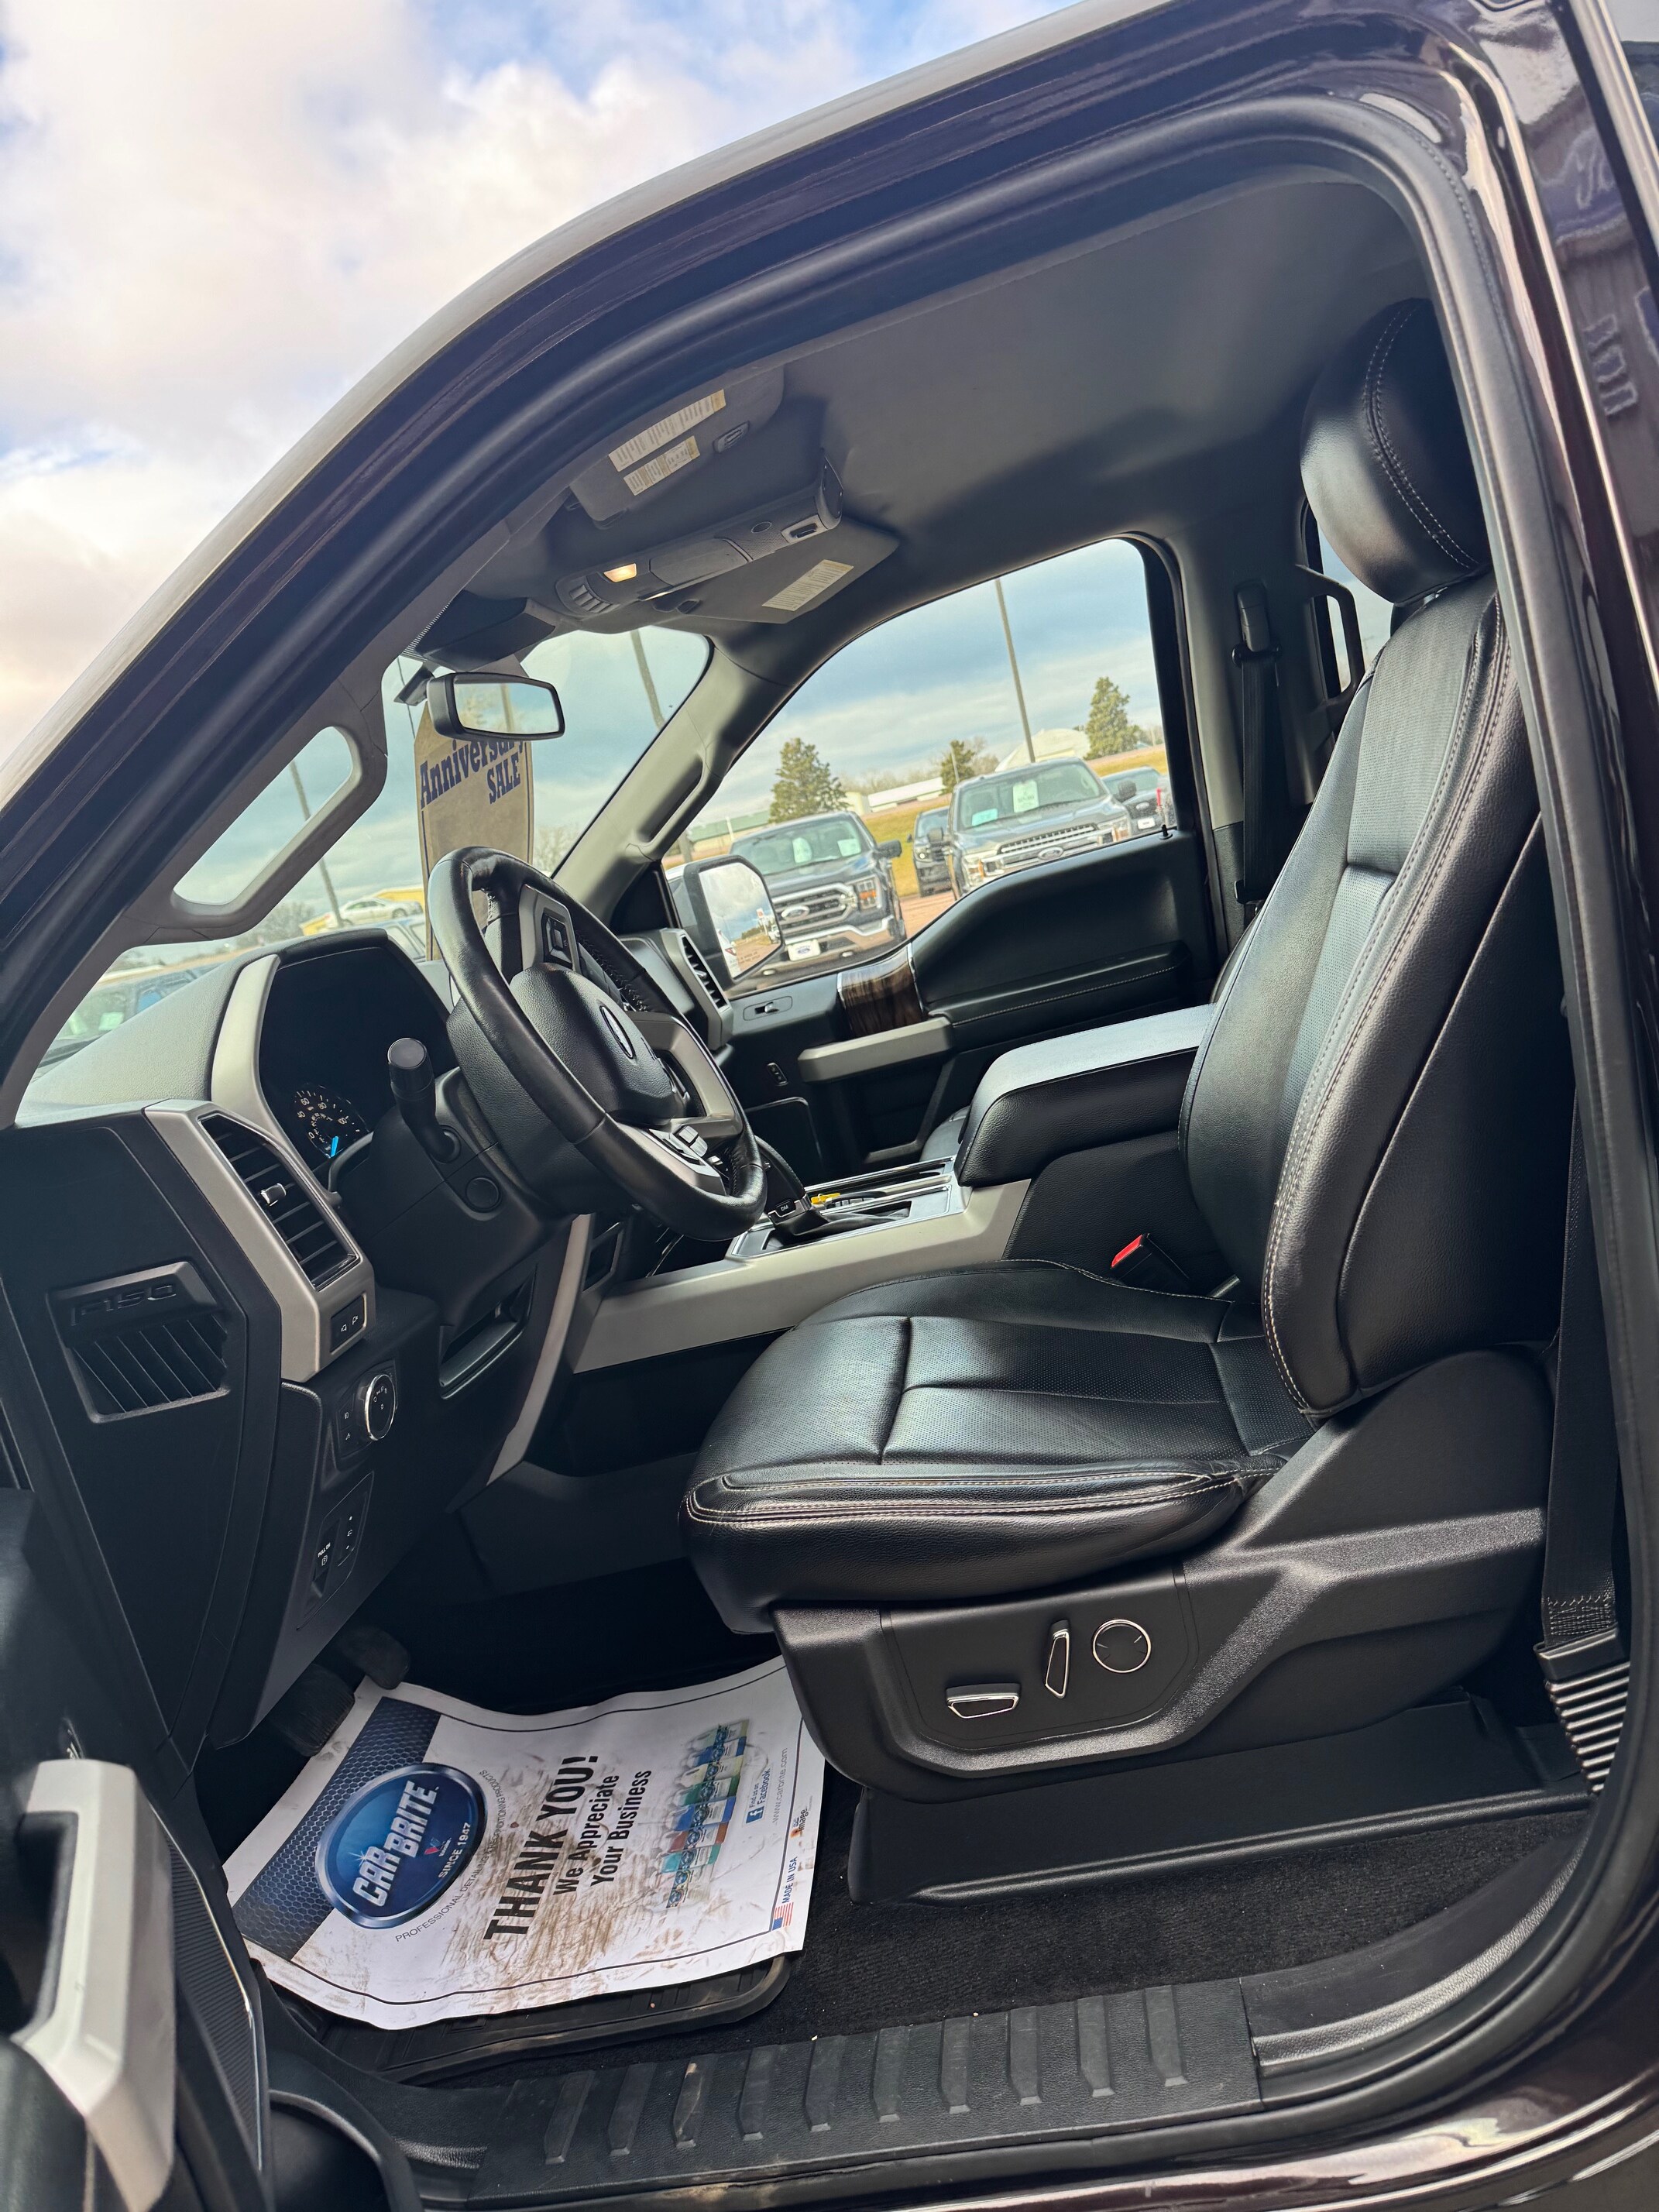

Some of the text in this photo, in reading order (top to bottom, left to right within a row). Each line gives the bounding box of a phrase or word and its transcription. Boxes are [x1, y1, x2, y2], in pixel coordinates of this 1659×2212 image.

[420, 739, 524, 809] Annivers
[487, 752, 520, 804] SALE
[590, 1770, 652, 1887] Your Business
[757, 1768, 771, 1805] Facebook
[352, 1781, 438, 1907] CAR BRITE
[395, 1892, 464, 1942] PROFESSIONAL
[460, 1854, 489, 1892] DETAILING
[479, 1769, 503, 1797] PRODUCTS
[438, 1849, 463, 1878] SINCE
[458, 1822, 471, 1846] 1947
[483, 1755, 599, 1940] THANK YOU!
[553, 1775, 620, 1895] We Appreciate
[781, 1856, 798, 1904] MADE IN USA
